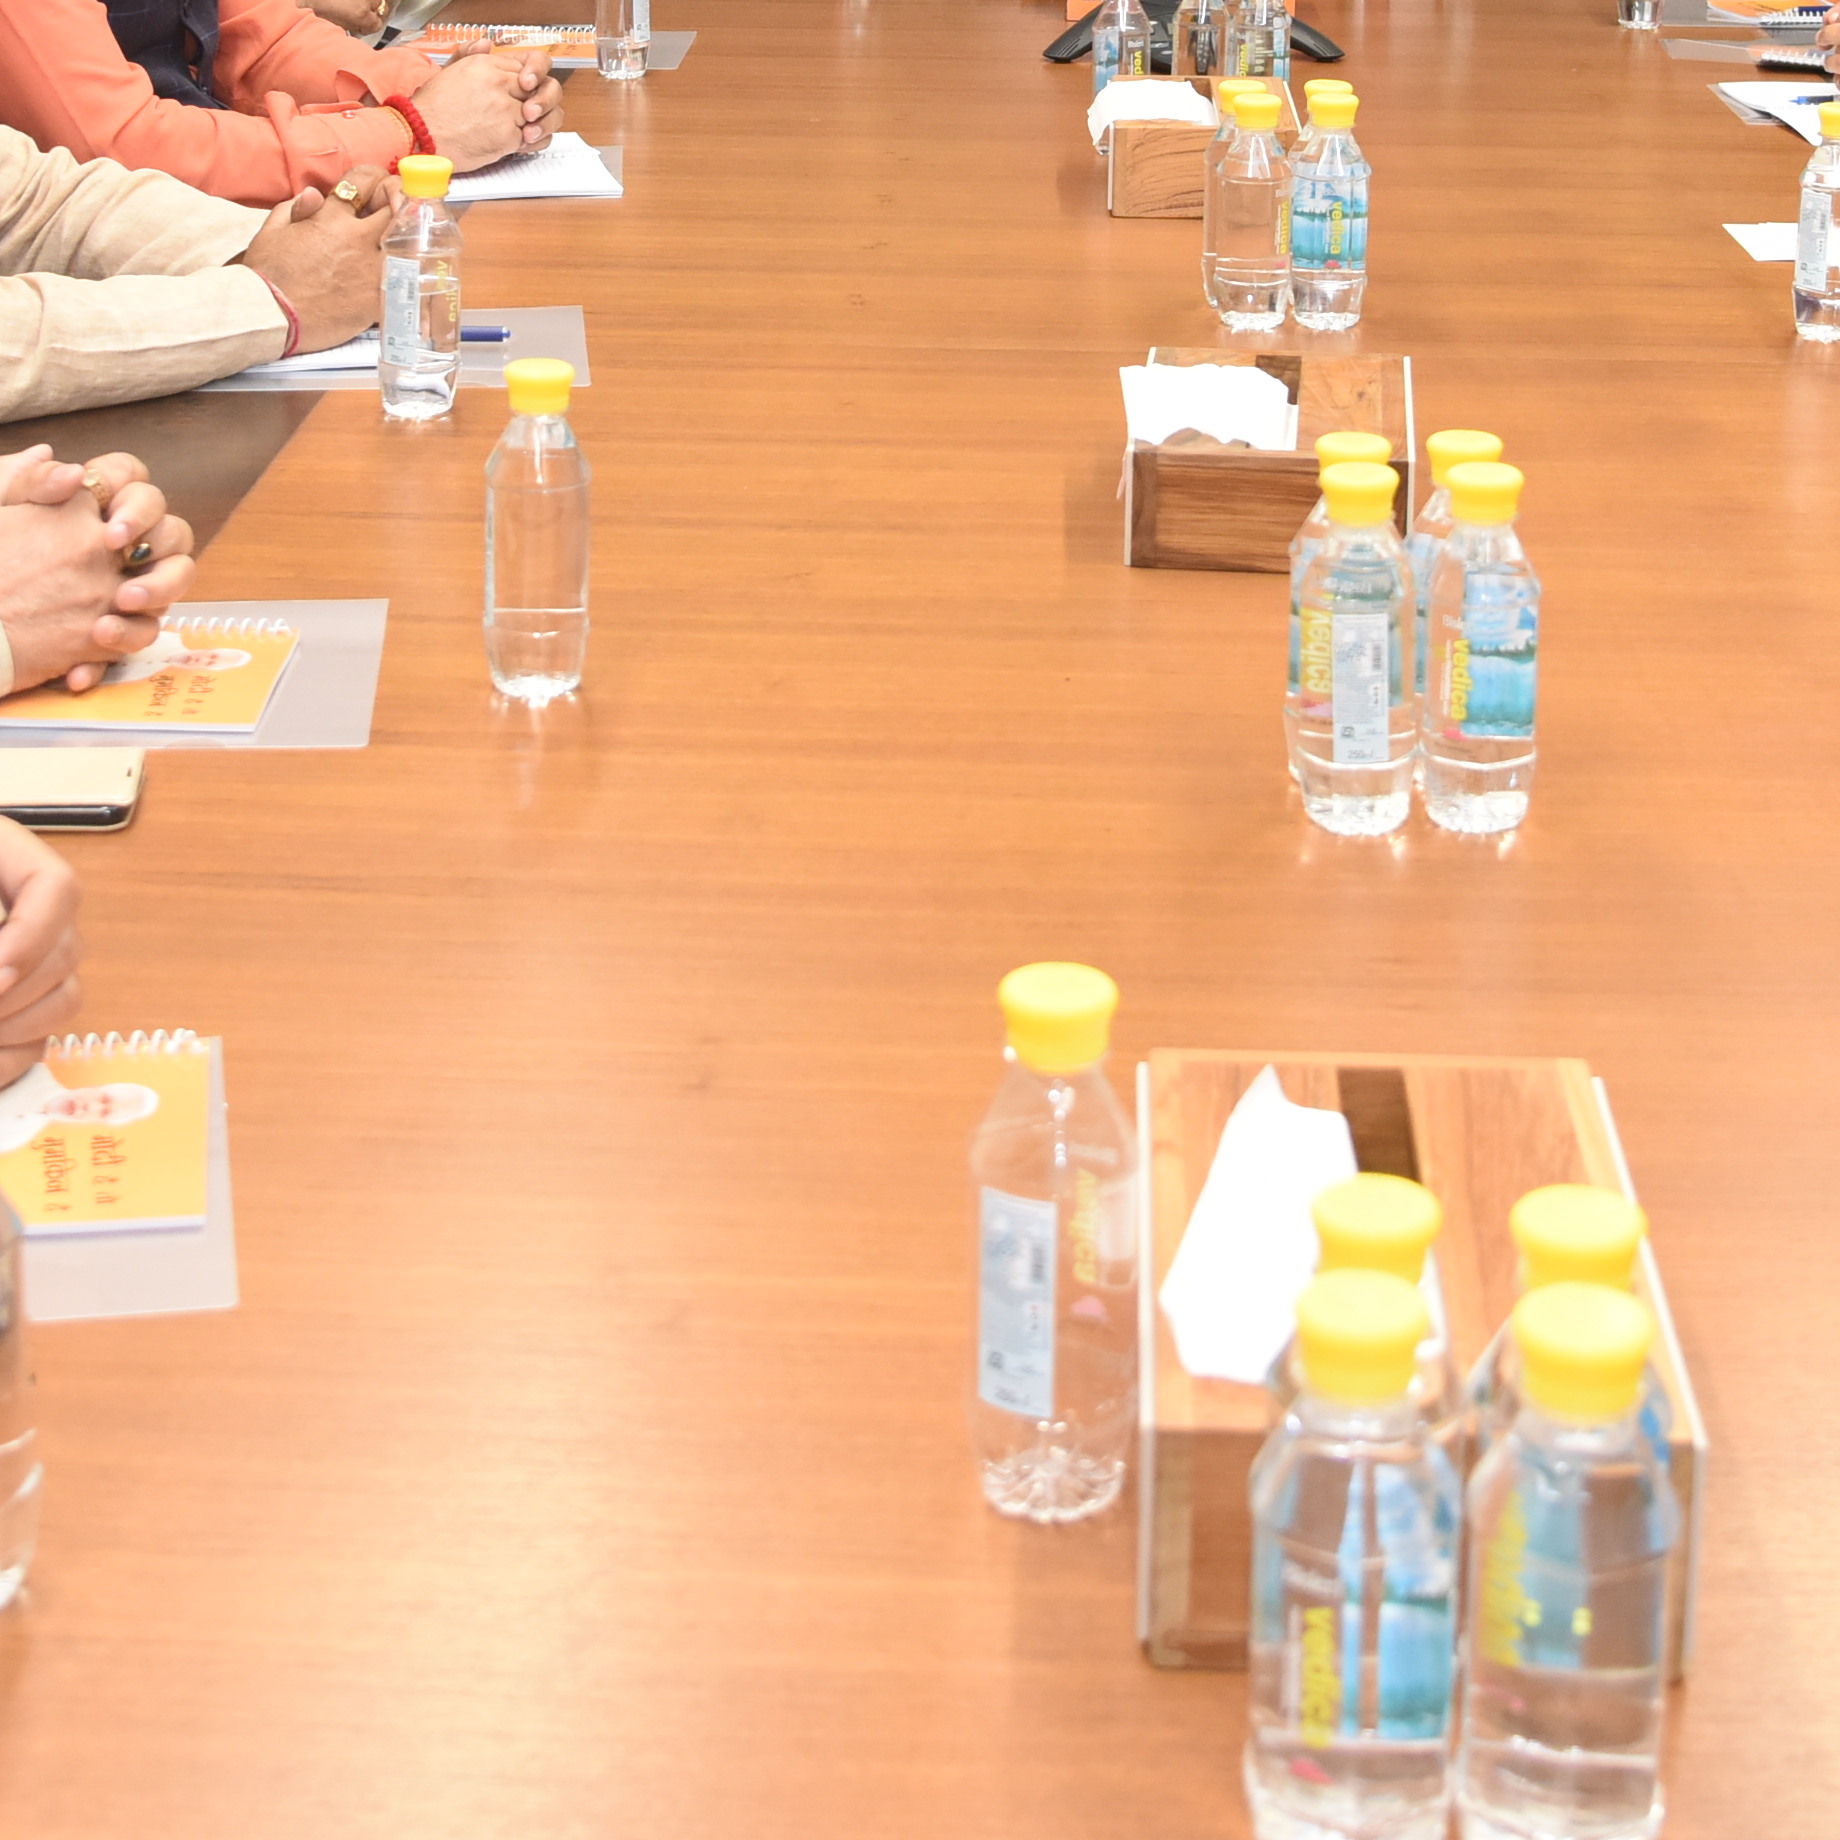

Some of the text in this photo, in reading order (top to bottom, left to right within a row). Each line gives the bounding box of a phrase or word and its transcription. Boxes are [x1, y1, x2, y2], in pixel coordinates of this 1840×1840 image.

[1134, 50, 1144, 76] ved
[1330, 201, 1344, 255] vedica
[1451, 639, 1473, 721] vedica
[30, 1136, 77, 1193] मुमकिन
[90, 1134, 126, 1166] मोदी
[1299, 1606, 1341, 1749] vedica
